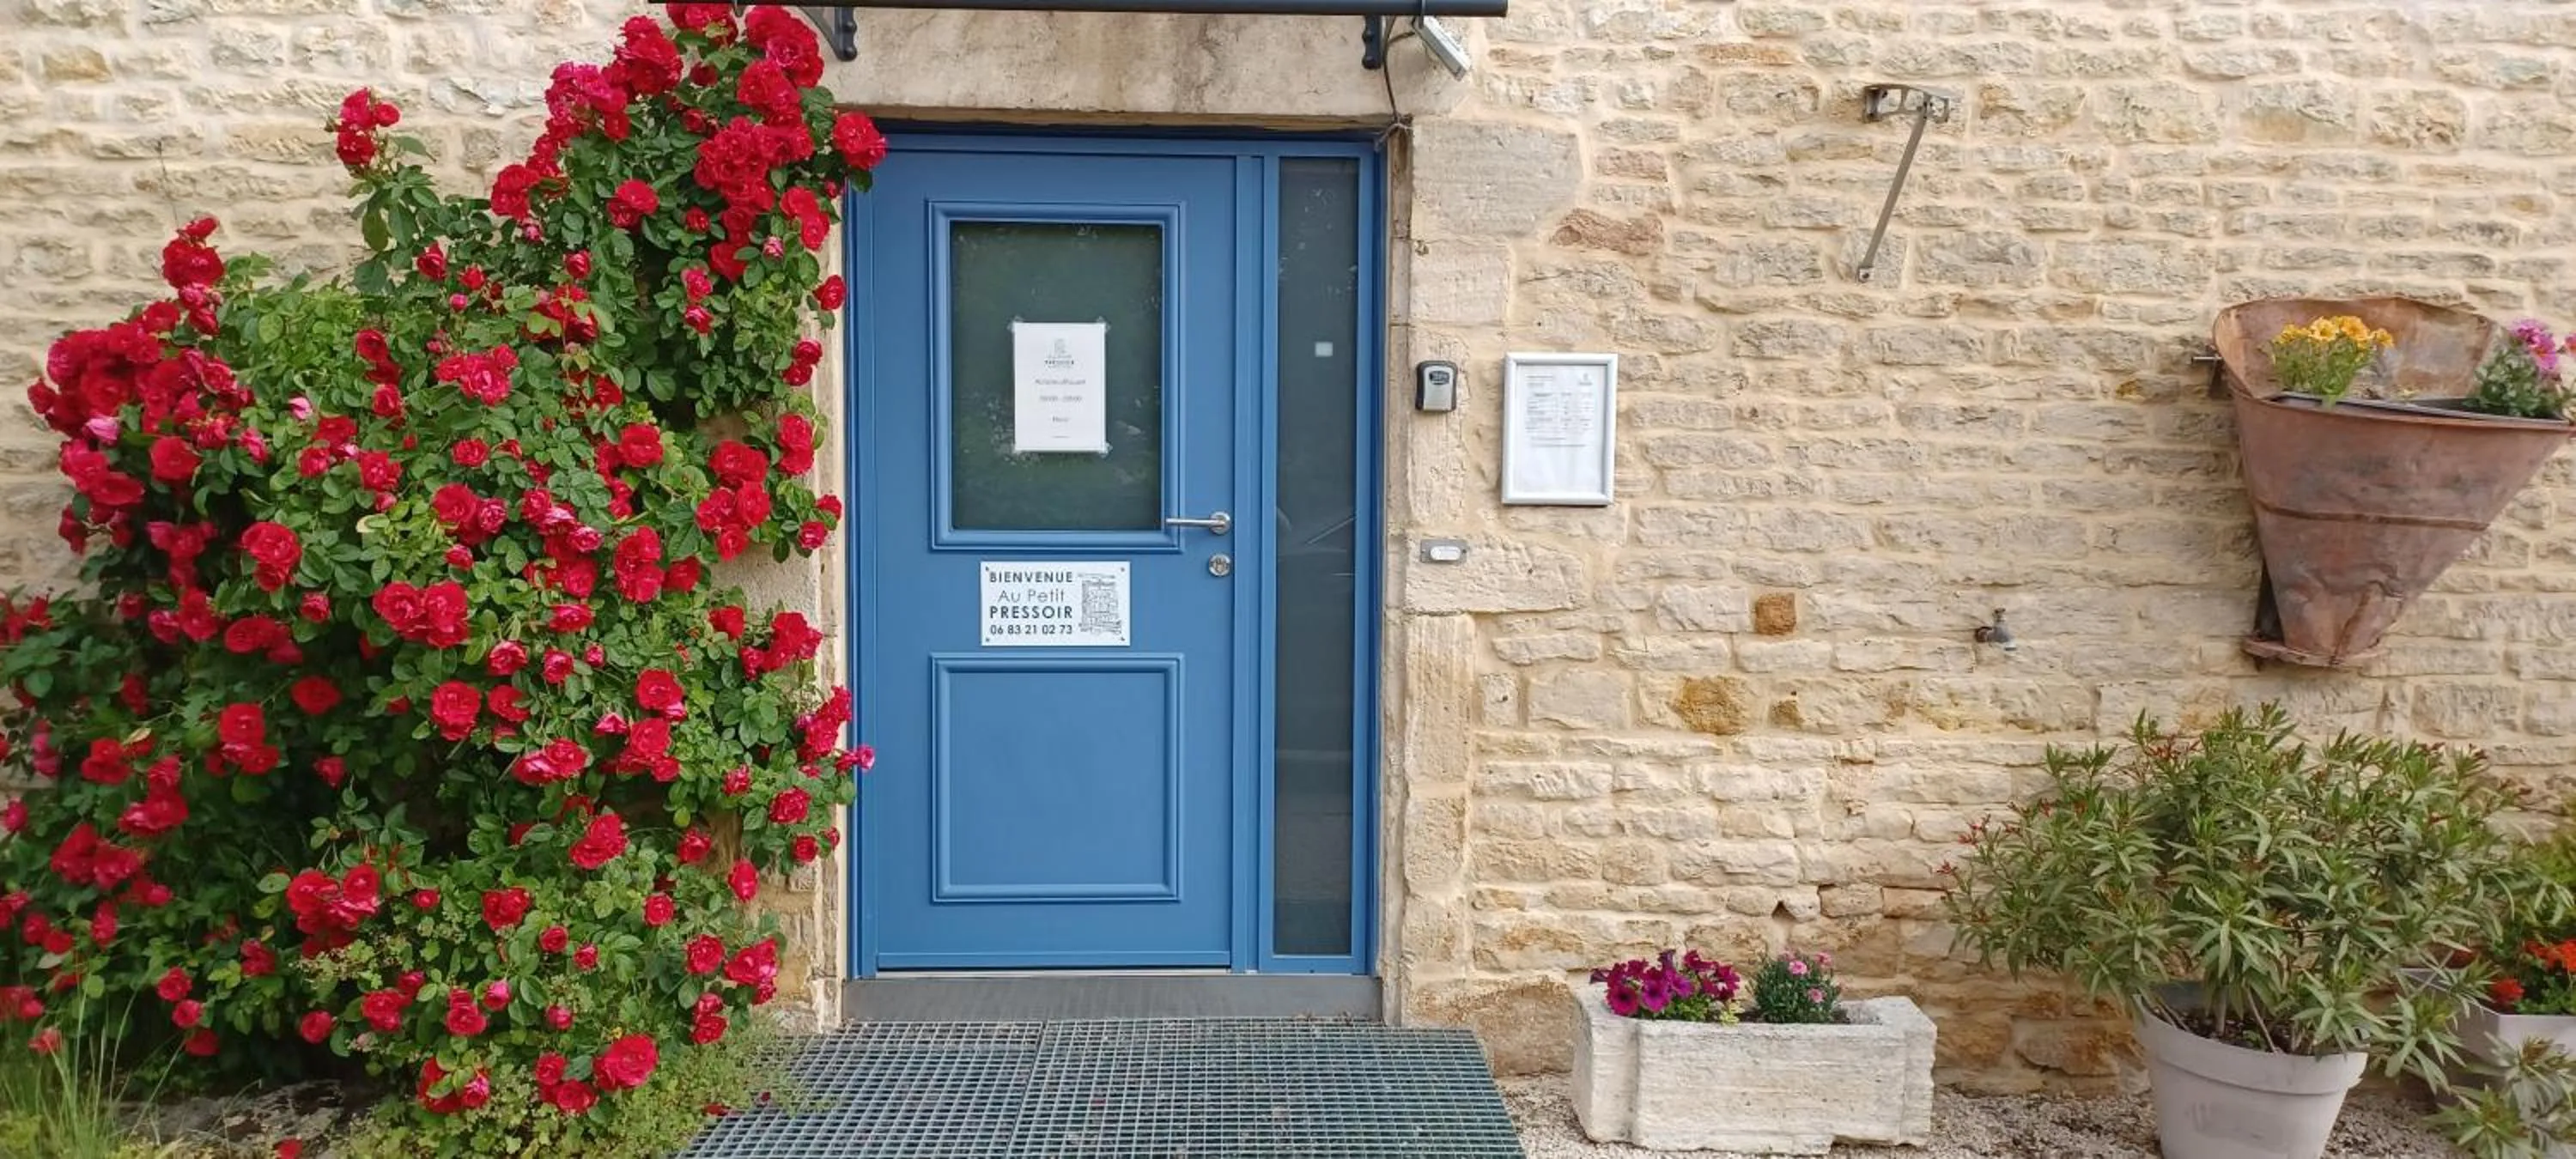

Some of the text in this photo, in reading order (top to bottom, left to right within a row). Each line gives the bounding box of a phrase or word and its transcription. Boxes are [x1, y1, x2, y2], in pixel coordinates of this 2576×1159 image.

[990, 571, 1072, 583] BIENVENUE
[998, 588, 1065, 603] Au Petit
[990, 605, 1072, 619] PRESSOIR
[990, 624, 1072, 634] 06 83 21 02 73
